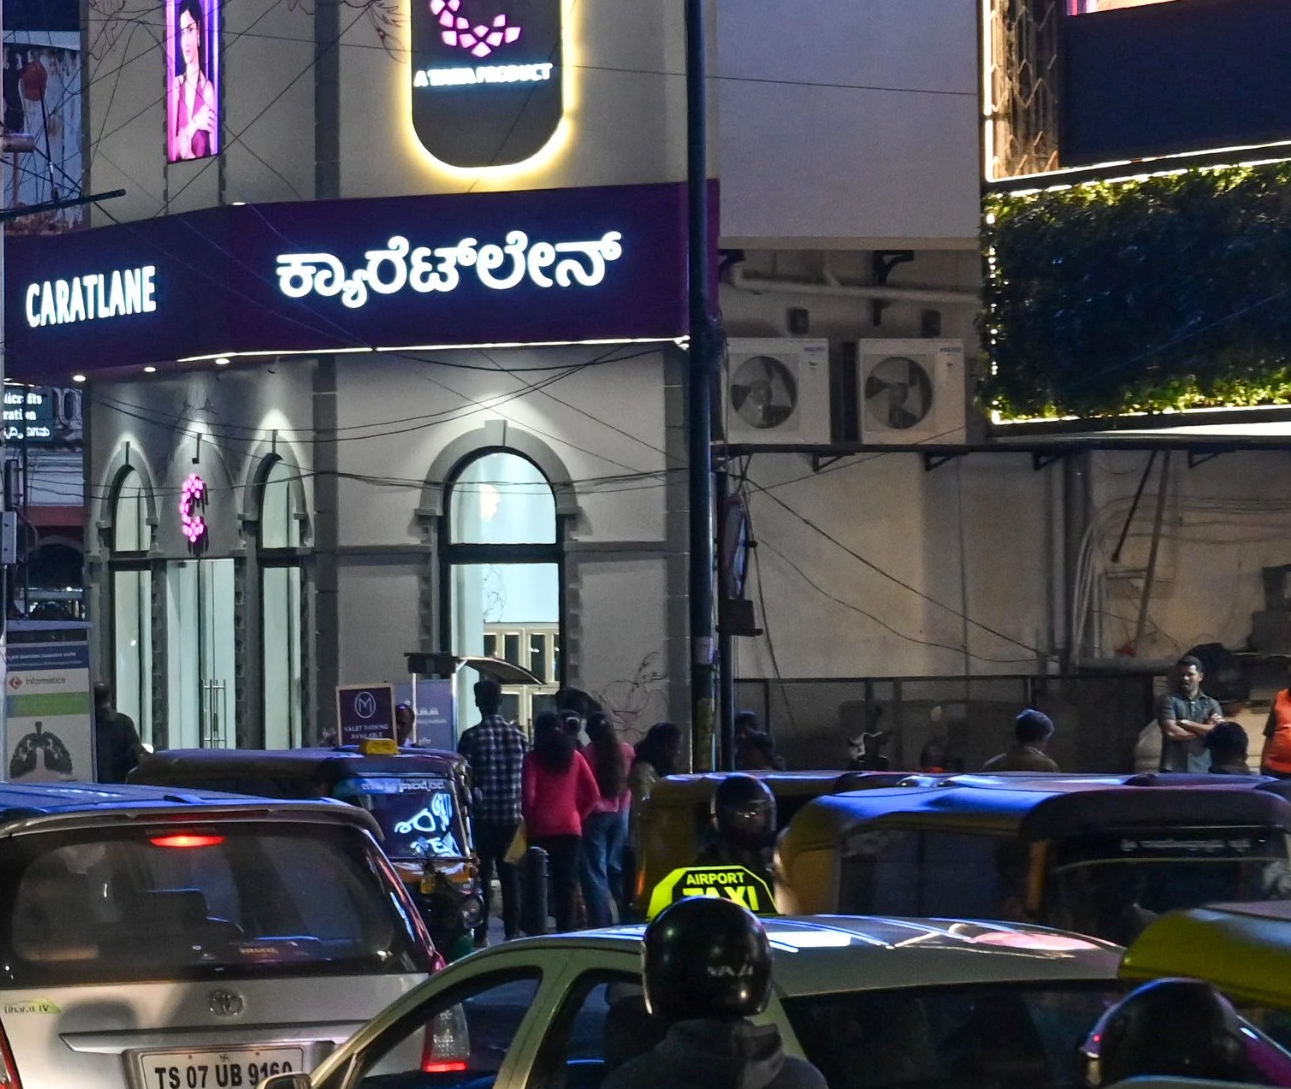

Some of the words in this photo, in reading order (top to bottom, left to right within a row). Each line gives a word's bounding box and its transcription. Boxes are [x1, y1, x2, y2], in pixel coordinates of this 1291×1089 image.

[476, 62, 554, 83] PRODUCT
[25, 265, 157, 328] CARATLANE
[686, 872, 745, 886] AIRPORT
[154, 1066, 181, 1089] TS
[186, 1065, 209, 1089] 07
[215, 1063, 243, 1088] UB
